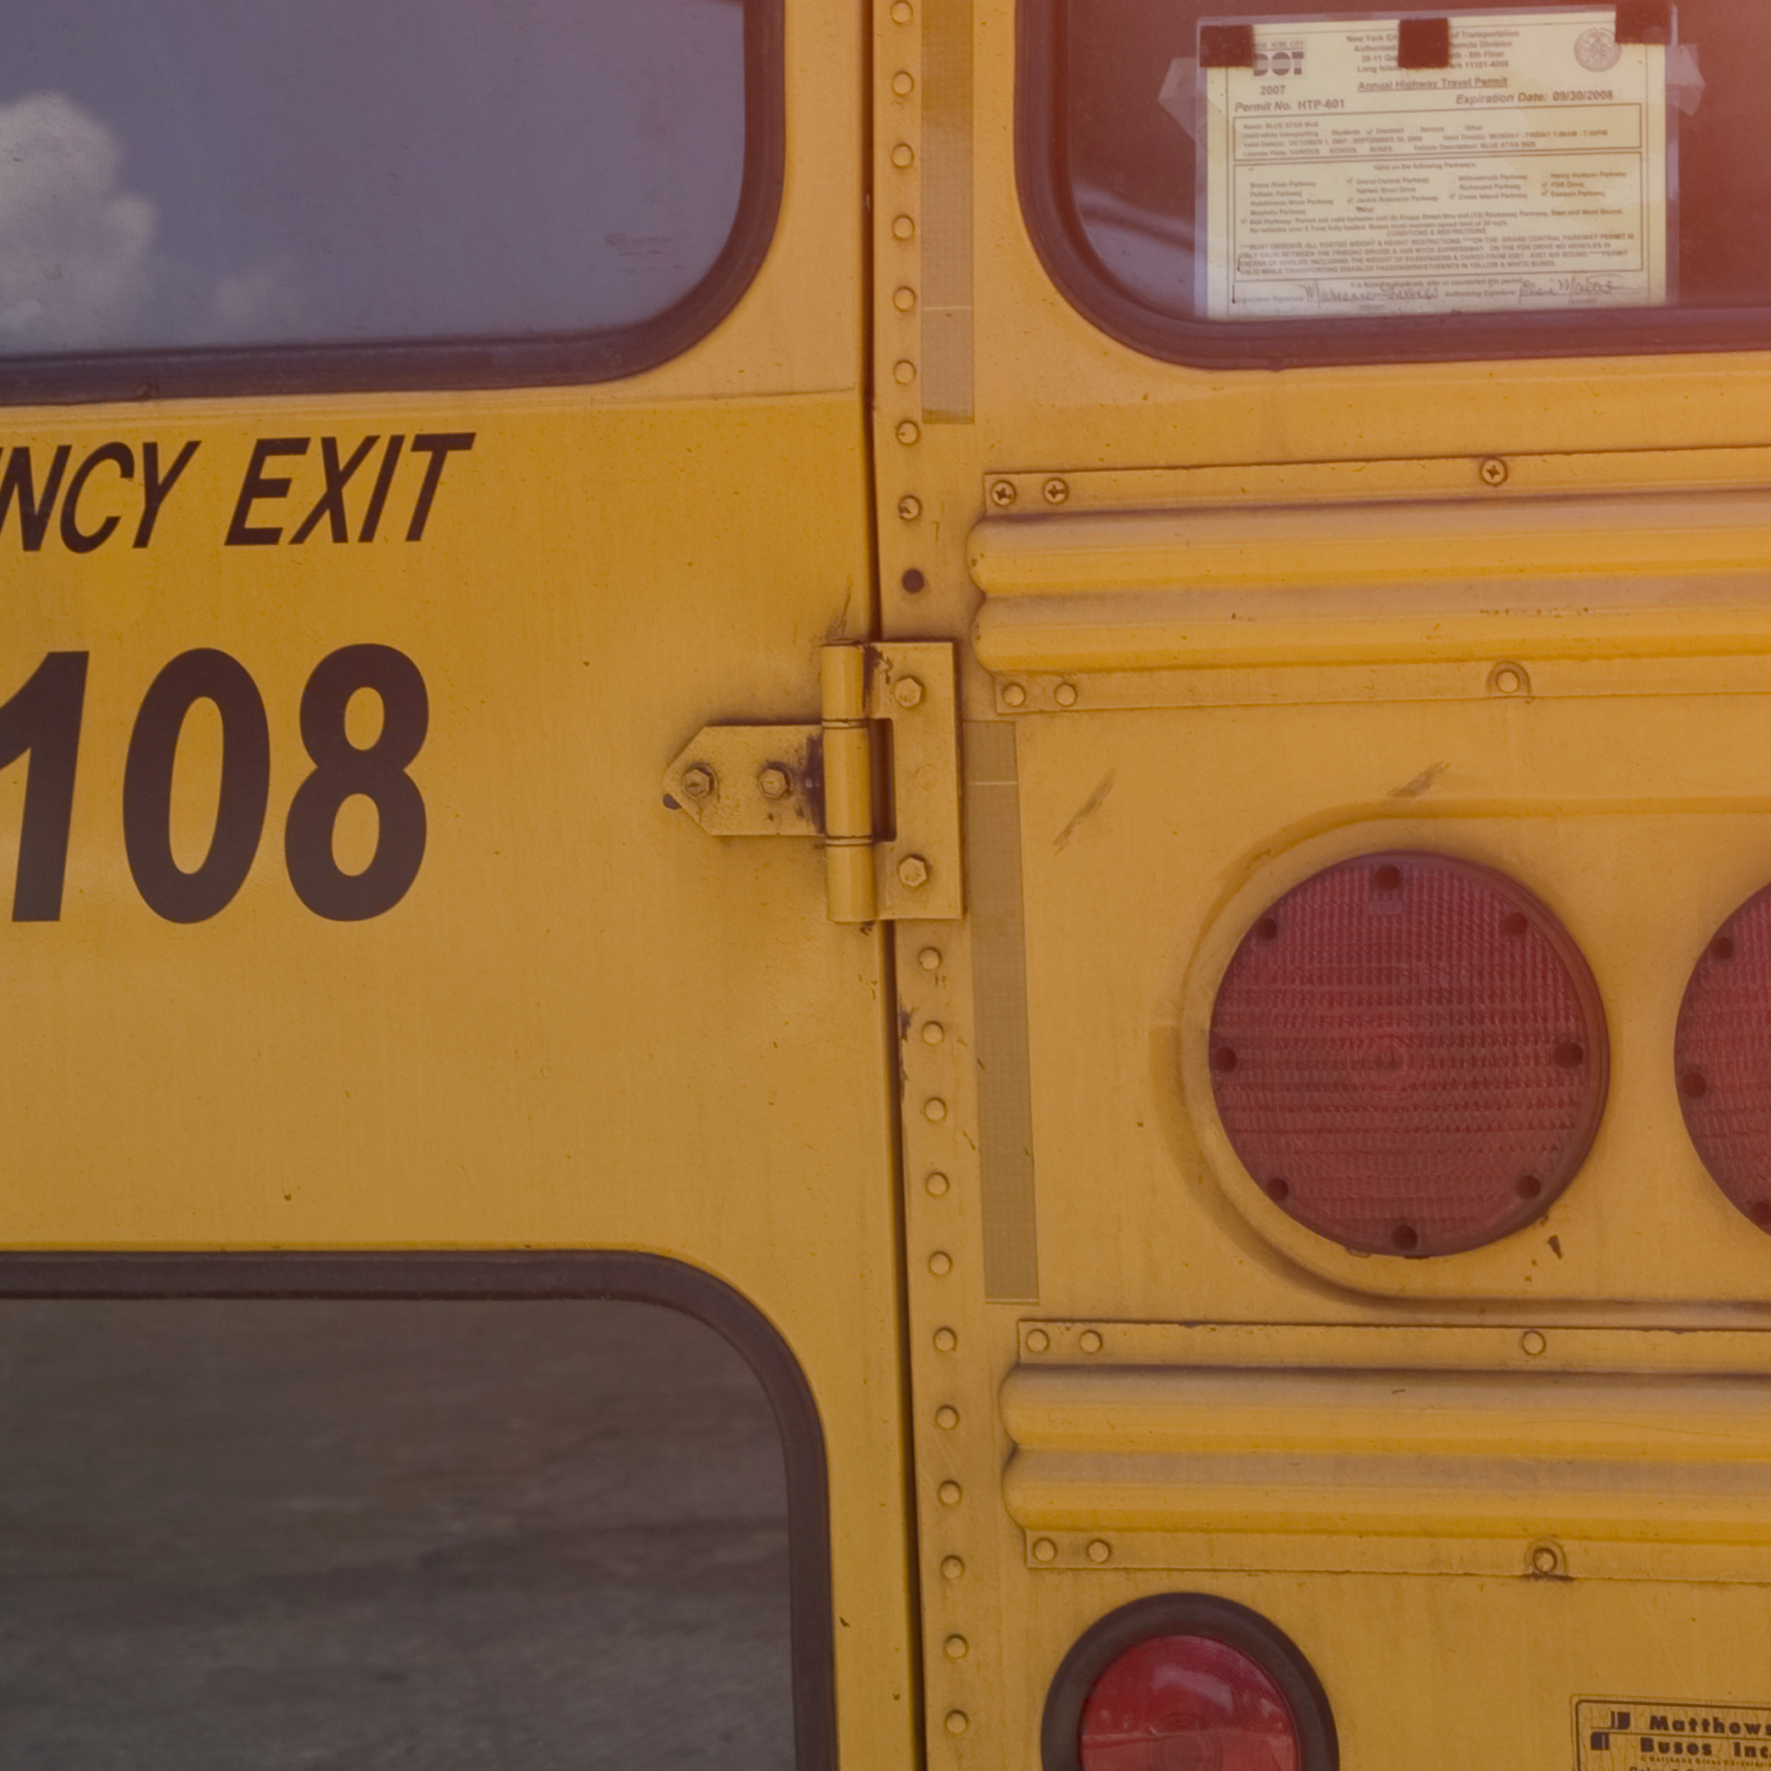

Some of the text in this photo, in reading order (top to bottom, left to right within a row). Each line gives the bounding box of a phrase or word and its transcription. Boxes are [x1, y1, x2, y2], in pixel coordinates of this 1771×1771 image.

[1346, 34, 1364, 42] New
[1365, 34, 1384, 42] York
[1461, 29, 1521, 39] Transportation
[1253, 51, 1304, 77] DOT
[1260, 84, 1287, 95] 2007
[1358, 75, 1509, 92] Annual Highway Travel Permit
[1455, 89, 1614, 105] Expiration Date: 09/30/2008
[1234, 101, 1272, 113] Permit
[1274, 101, 1293, 111] No.
[224, 432, 477, 547] EXIT
[1640, 1736, 1713, 1756] Buses
